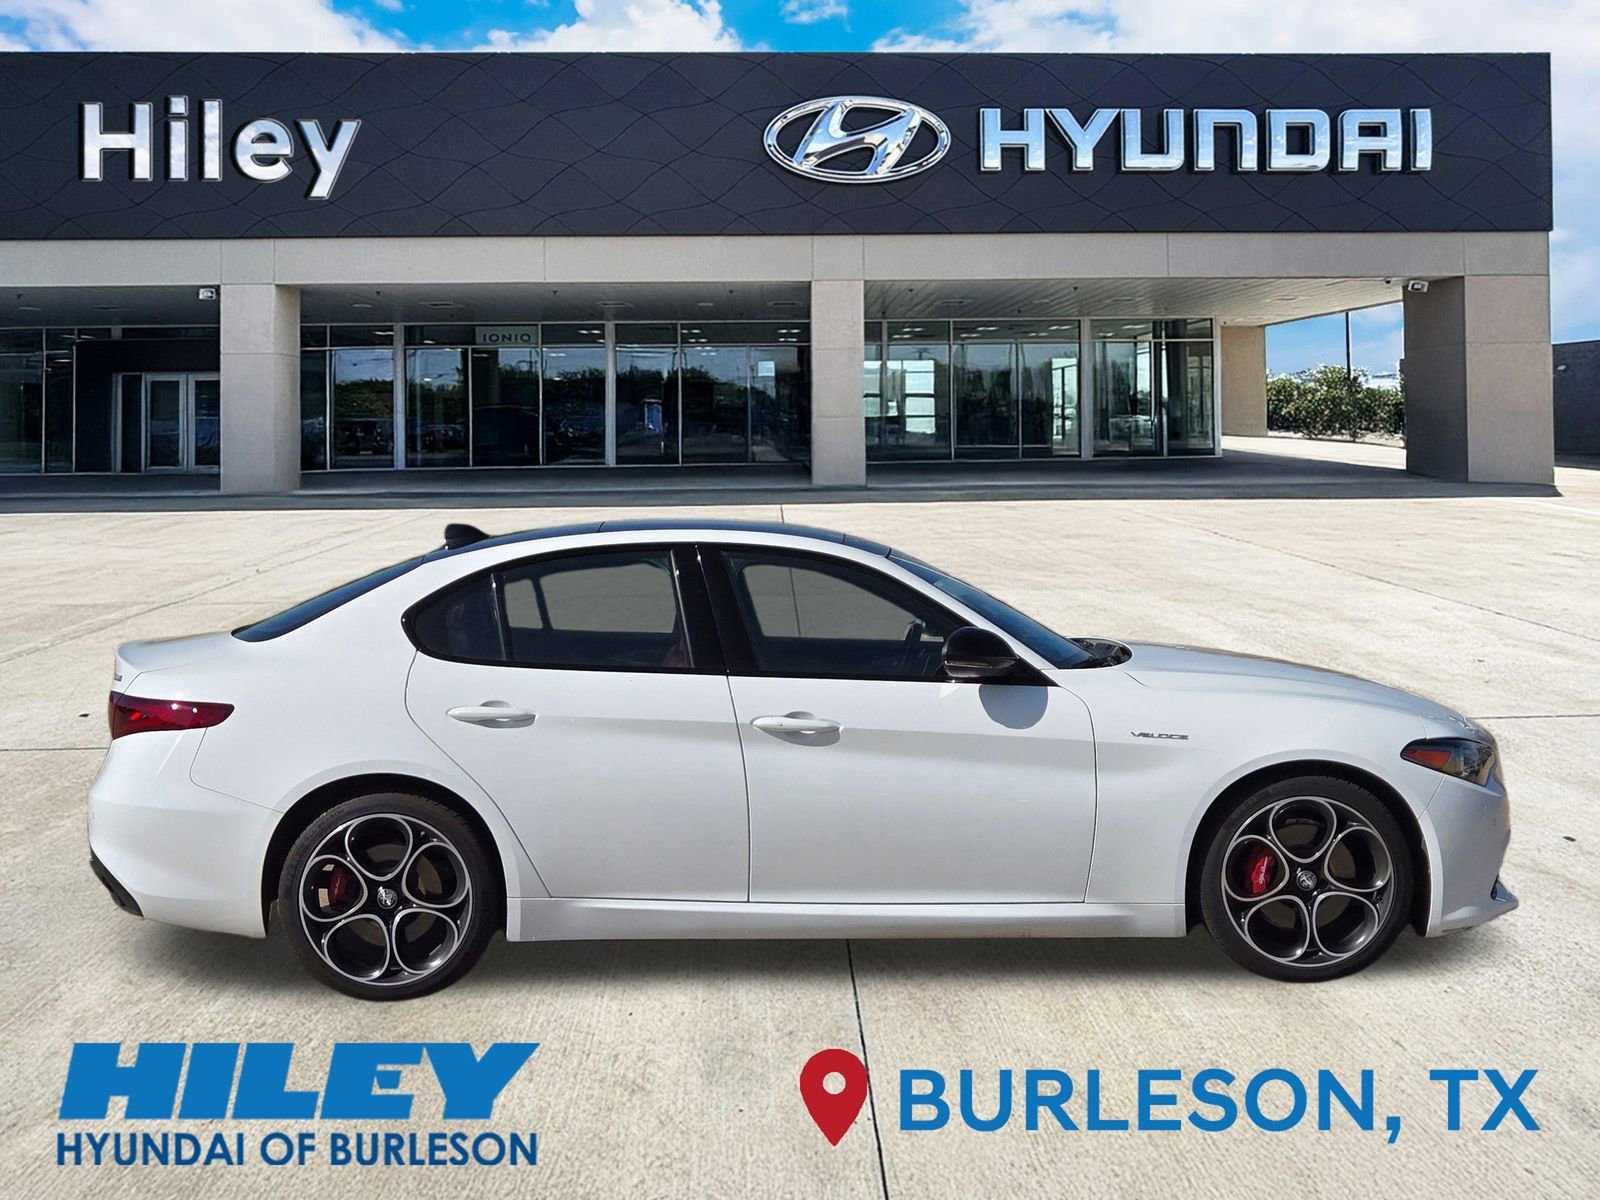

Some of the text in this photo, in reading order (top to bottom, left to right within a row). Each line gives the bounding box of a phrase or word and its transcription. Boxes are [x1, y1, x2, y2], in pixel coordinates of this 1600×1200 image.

[82, 95, 362, 200] Hiley
[979, 107, 1433, 173] HYUNDAI
[1130, 731, 1190, 741] VELOCE
